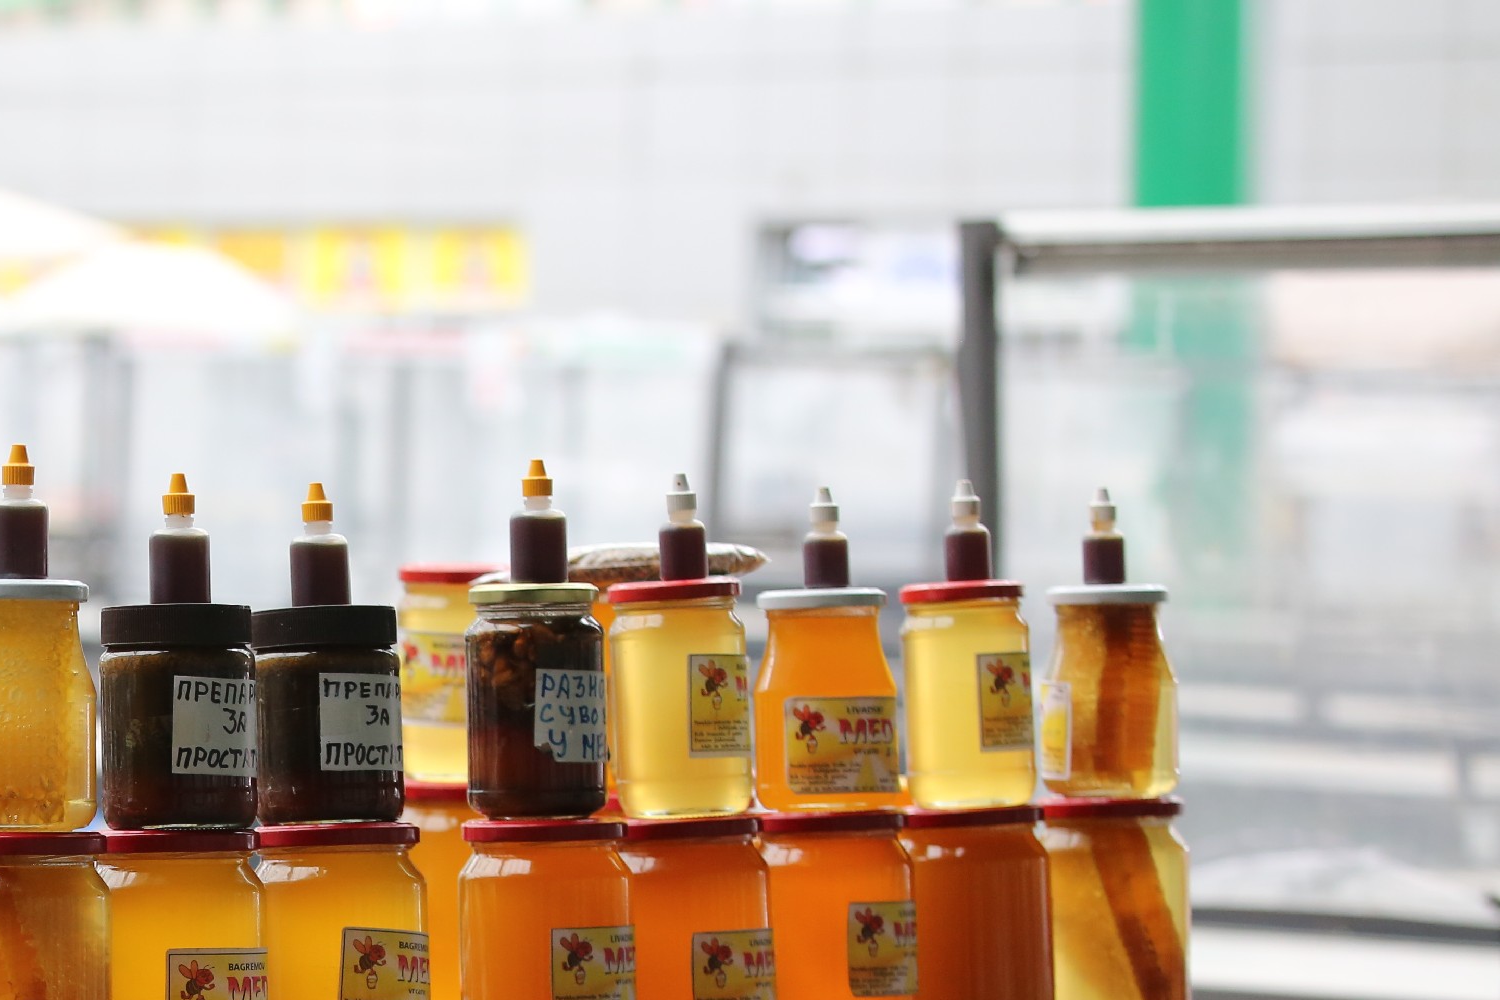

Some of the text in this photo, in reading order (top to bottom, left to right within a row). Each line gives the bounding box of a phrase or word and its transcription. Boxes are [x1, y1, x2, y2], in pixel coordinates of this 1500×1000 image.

[177, 680, 256, 704] ПРЕПАР
[222, 708, 246, 734] ЗА
[366, 705, 389, 726] ЗА
[549, 729, 567, 758] У
[839, 718, 892, 744] MED
[397, 955, 430, 985] ME
[743, 950, 775, 978] ME
